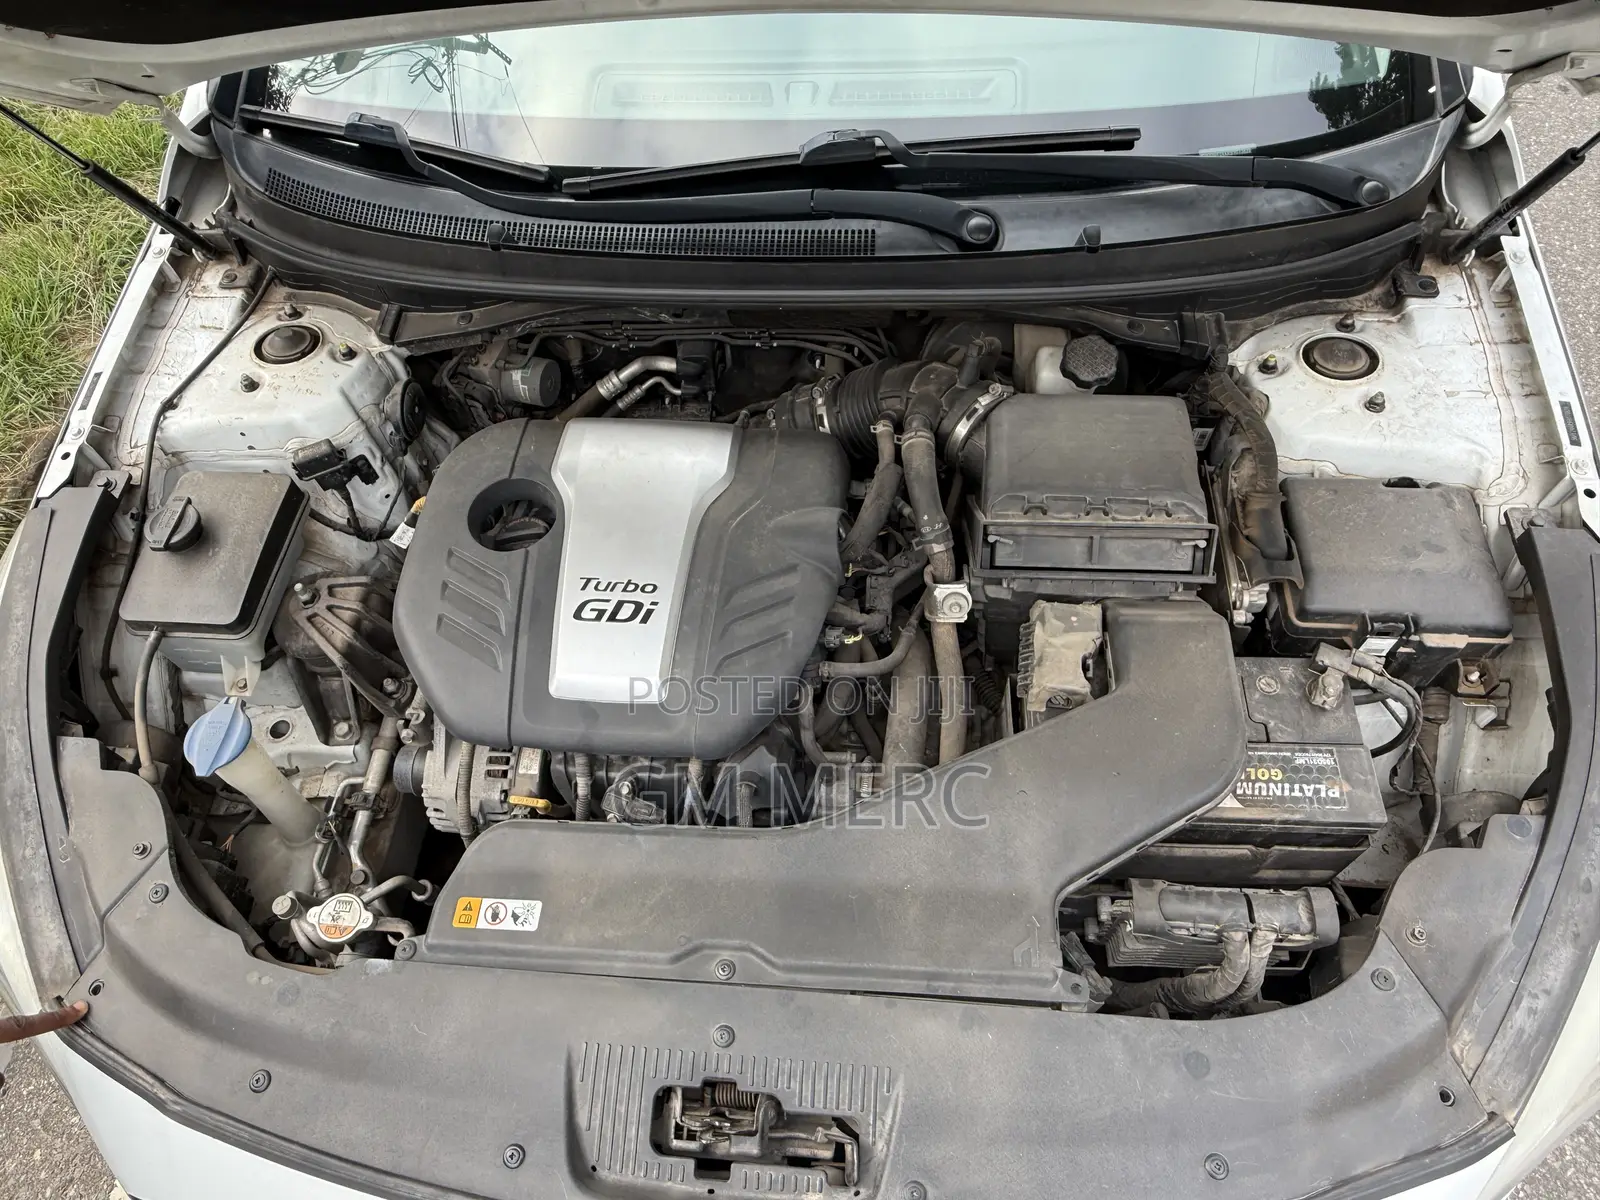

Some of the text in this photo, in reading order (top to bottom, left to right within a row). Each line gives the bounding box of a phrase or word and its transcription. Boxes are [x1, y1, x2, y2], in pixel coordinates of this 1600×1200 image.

[579, 577, 659, 594] Turbo
[572, 598, 660, 624] GDi
[1241, 767, 1283, 781] GOL
[1236, 781, 1341, 798] PLATINUM
